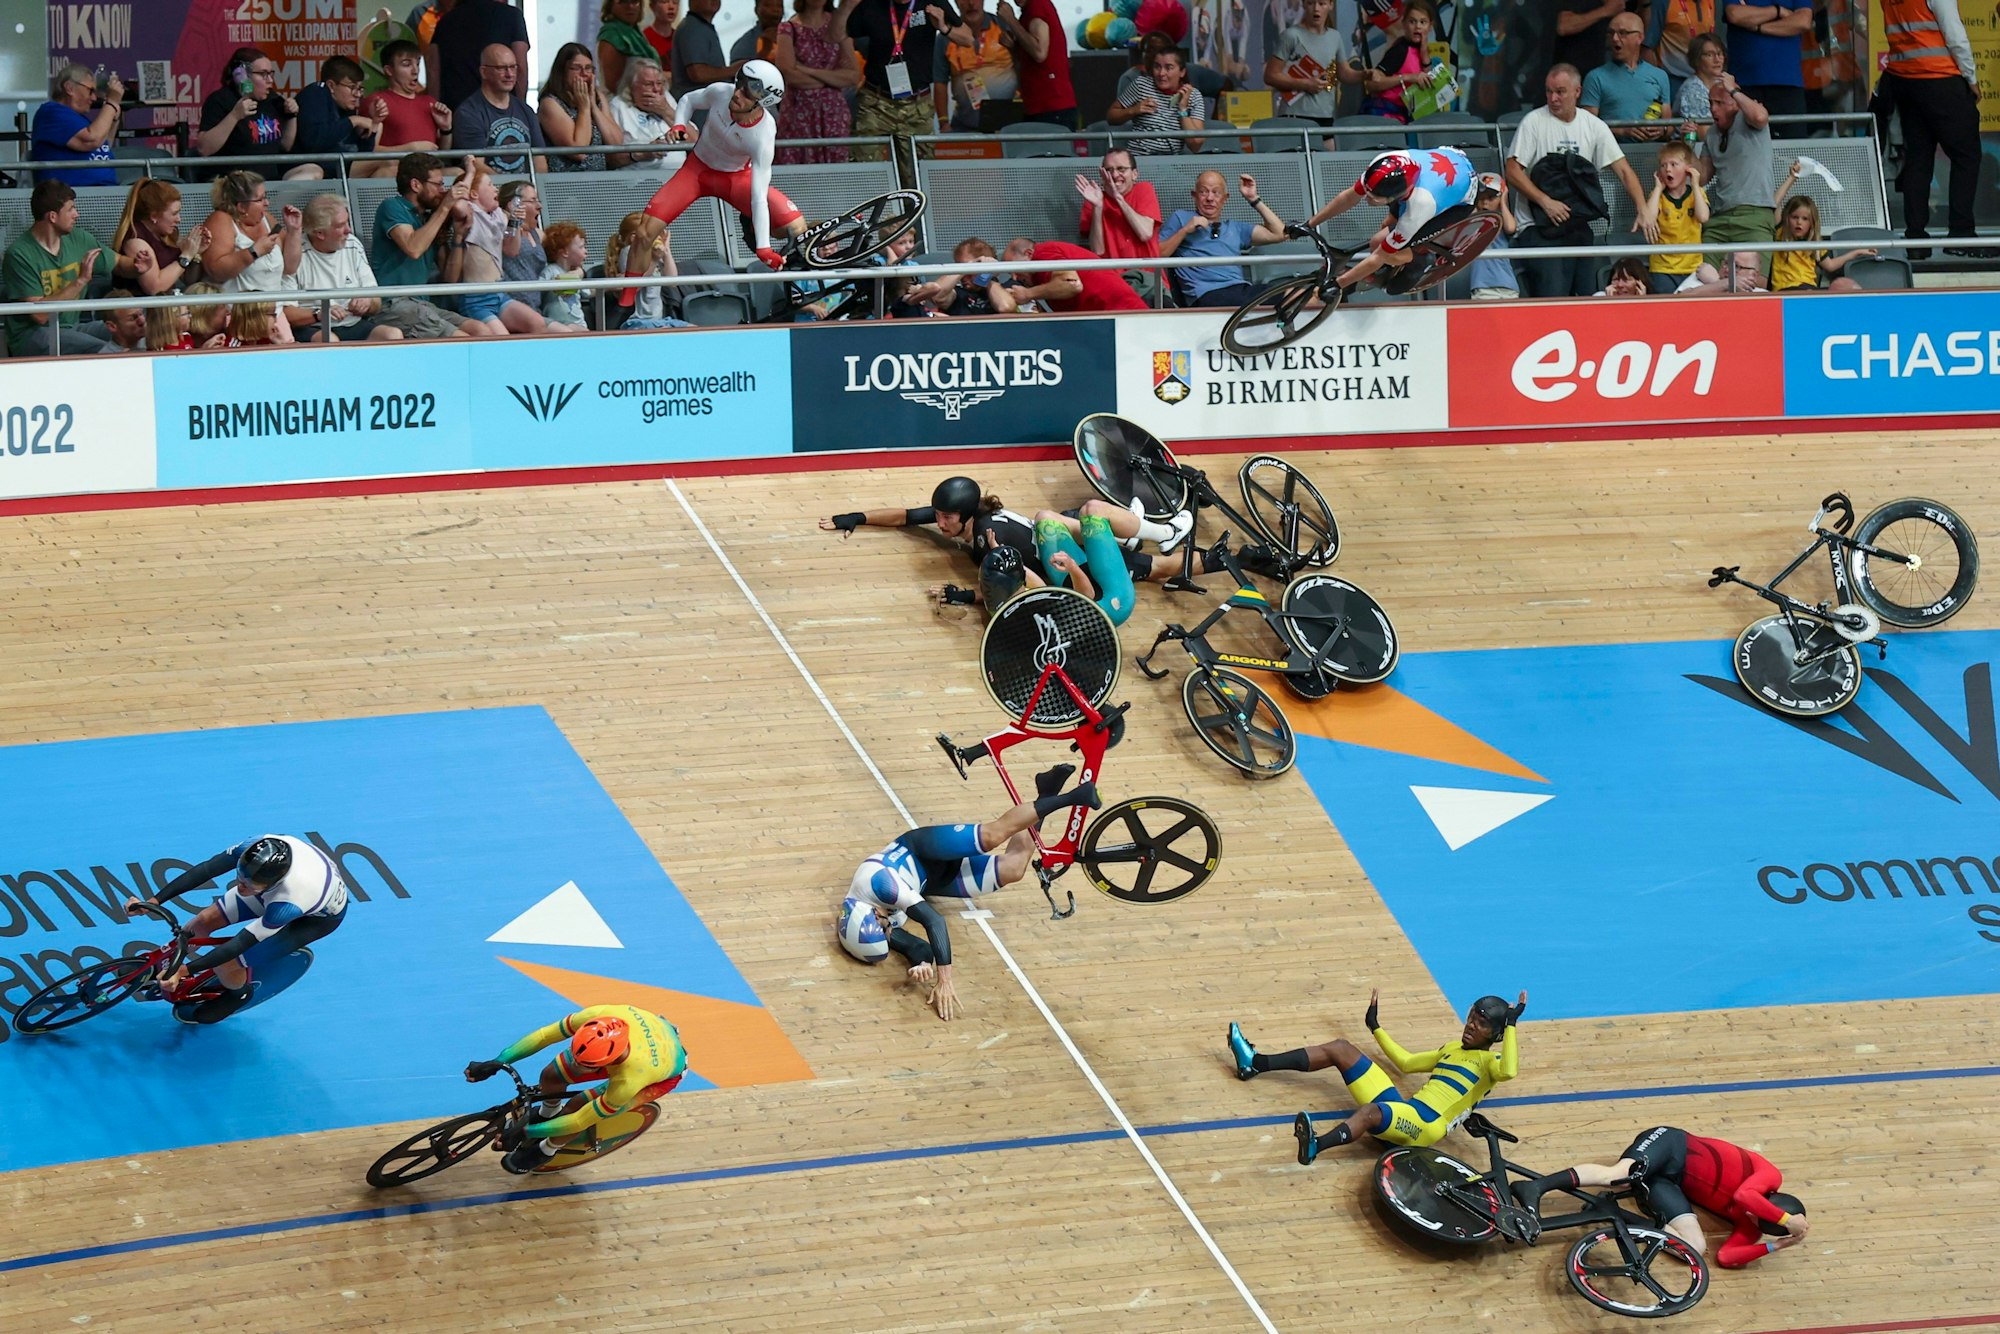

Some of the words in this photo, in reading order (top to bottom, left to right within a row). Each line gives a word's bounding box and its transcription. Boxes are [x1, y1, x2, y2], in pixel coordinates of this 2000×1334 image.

[50, 4, 64, 49] TO
[67, 4, 131, 49] KNOW
[228, 24, 240, 42] THE
[240, 24, 252, 42] LEE
[252, 24, 282, 42] VALLEY
[284, 23, 339, 41] VELOPARK
[284, 45, 306, 56] WAS
[308, 45, 336, 56] MADE
[796, 217, 840, 243] LOTUS
[843, 349, 1063, 392] LONGINES
[1206, 343, 1388, 372] UNIVERSITY
[1386, 343, 1410, 361] OF
[598, 370, 756, 399] commonwealth
[1206, 375, 1411, 406] BIRMINGHAM
[188, 396, 361, 441] BIRMINGHAM
[370, 392, 436, 431] 2022
[641, 397, 713, 424] games
[1248, 459, 1288, 477] CORIMA
[1294, 576, 1357, 600] ZIPP
[1370, 608, 1394, 671] ZIPP
[1218, 654, 1271, 668] ARGON
[1273, 660, 1289, 669] 18
[1761, 647, 1856, 710] BROTHERS
[628, 1006, 659, 1068] GRENADA
[1394, 1116, 1423, 1141] BARBADOS
[1636, 1138, 1652, 1152] MAN
